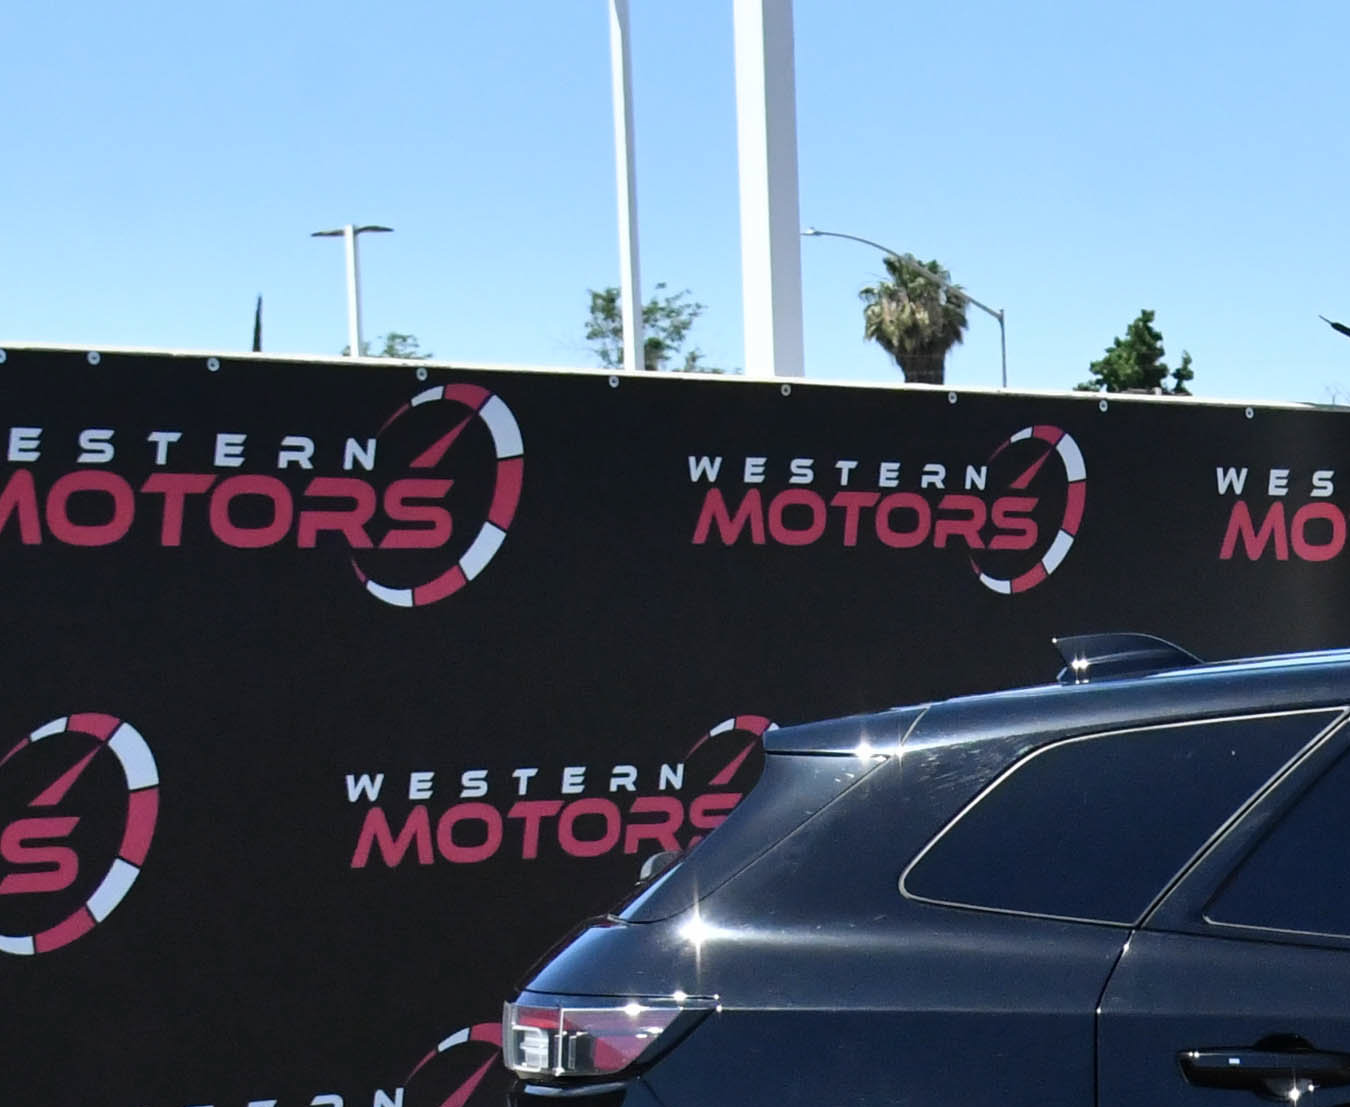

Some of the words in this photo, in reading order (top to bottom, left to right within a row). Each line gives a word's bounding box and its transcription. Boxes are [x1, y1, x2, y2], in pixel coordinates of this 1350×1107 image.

[688, 455, 988, 491] WESTERN
[693, 487, 1040, 550] MOTORS
[345, 763, 685, 803] WESTERN
